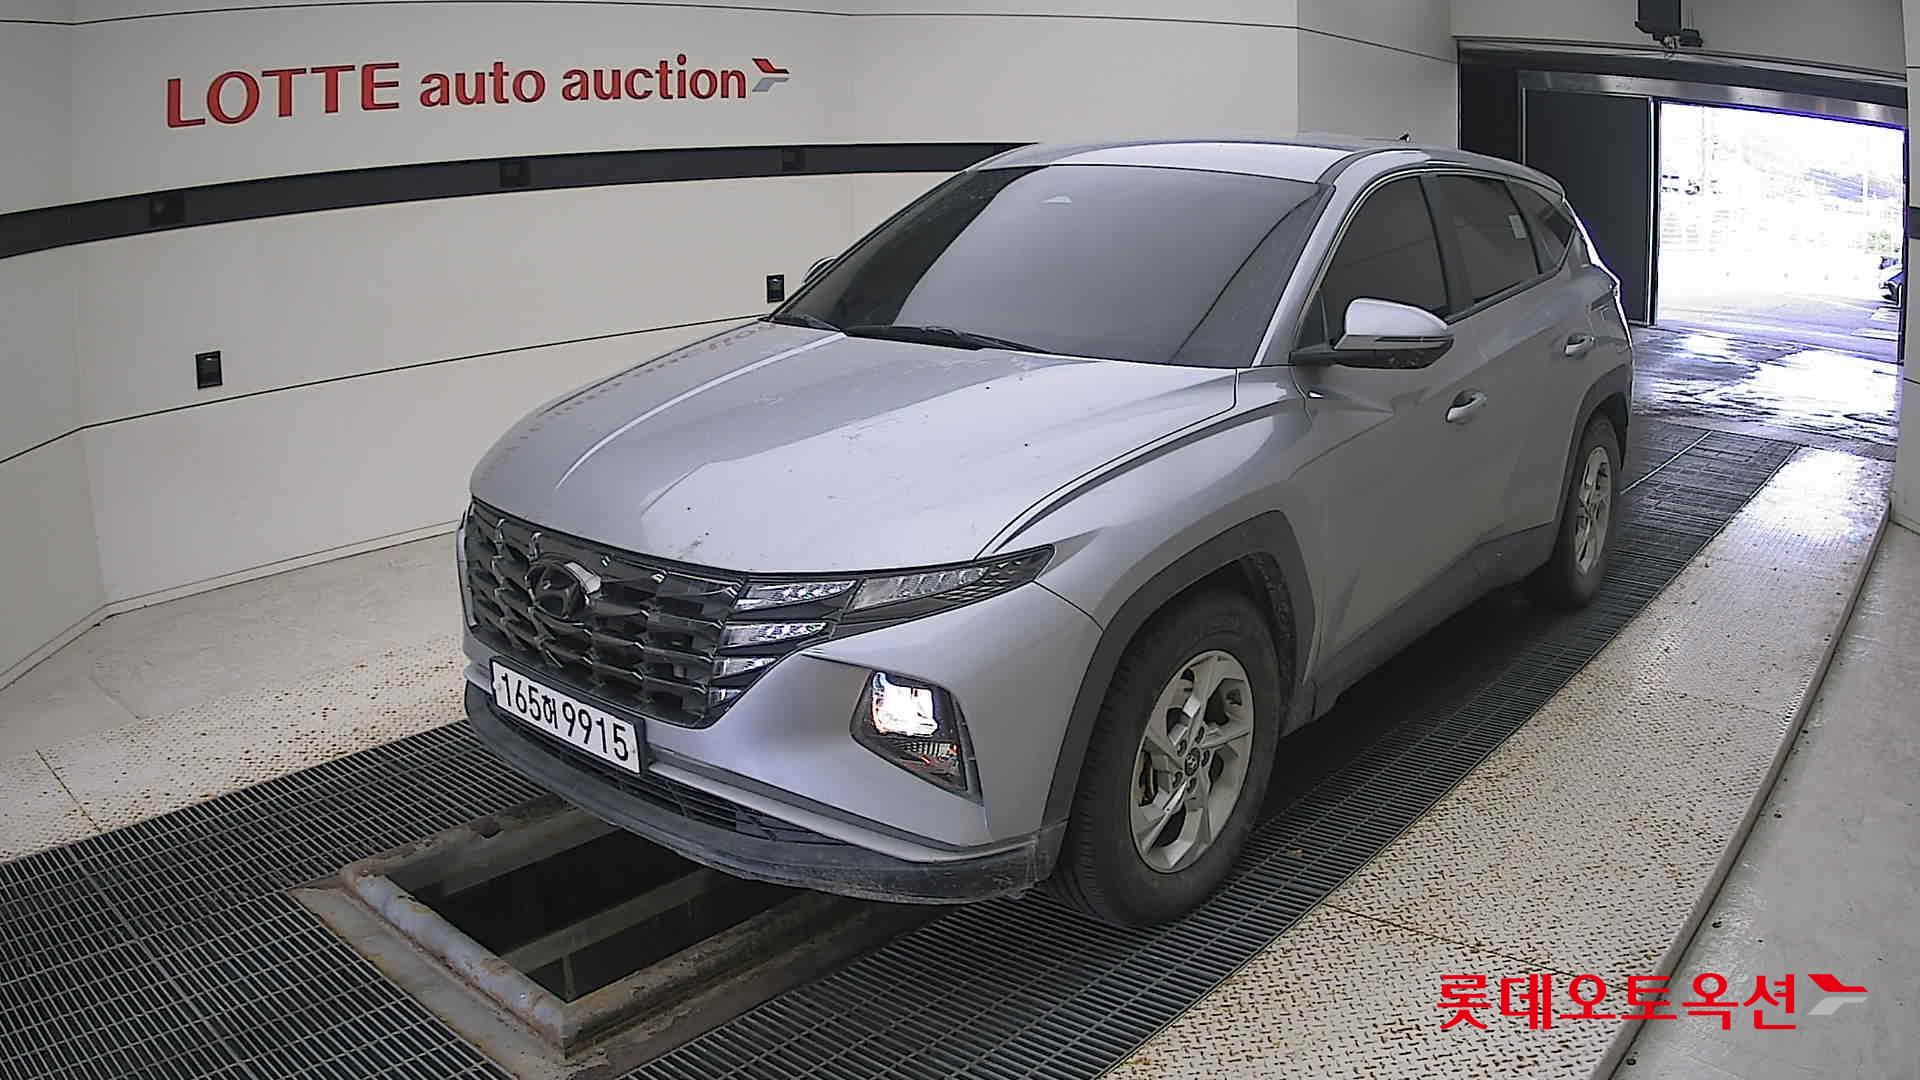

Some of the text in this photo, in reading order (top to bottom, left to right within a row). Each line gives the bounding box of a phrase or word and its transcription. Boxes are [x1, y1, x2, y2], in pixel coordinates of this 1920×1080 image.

[166, 54, 747, 128] LOTTE auto auction
